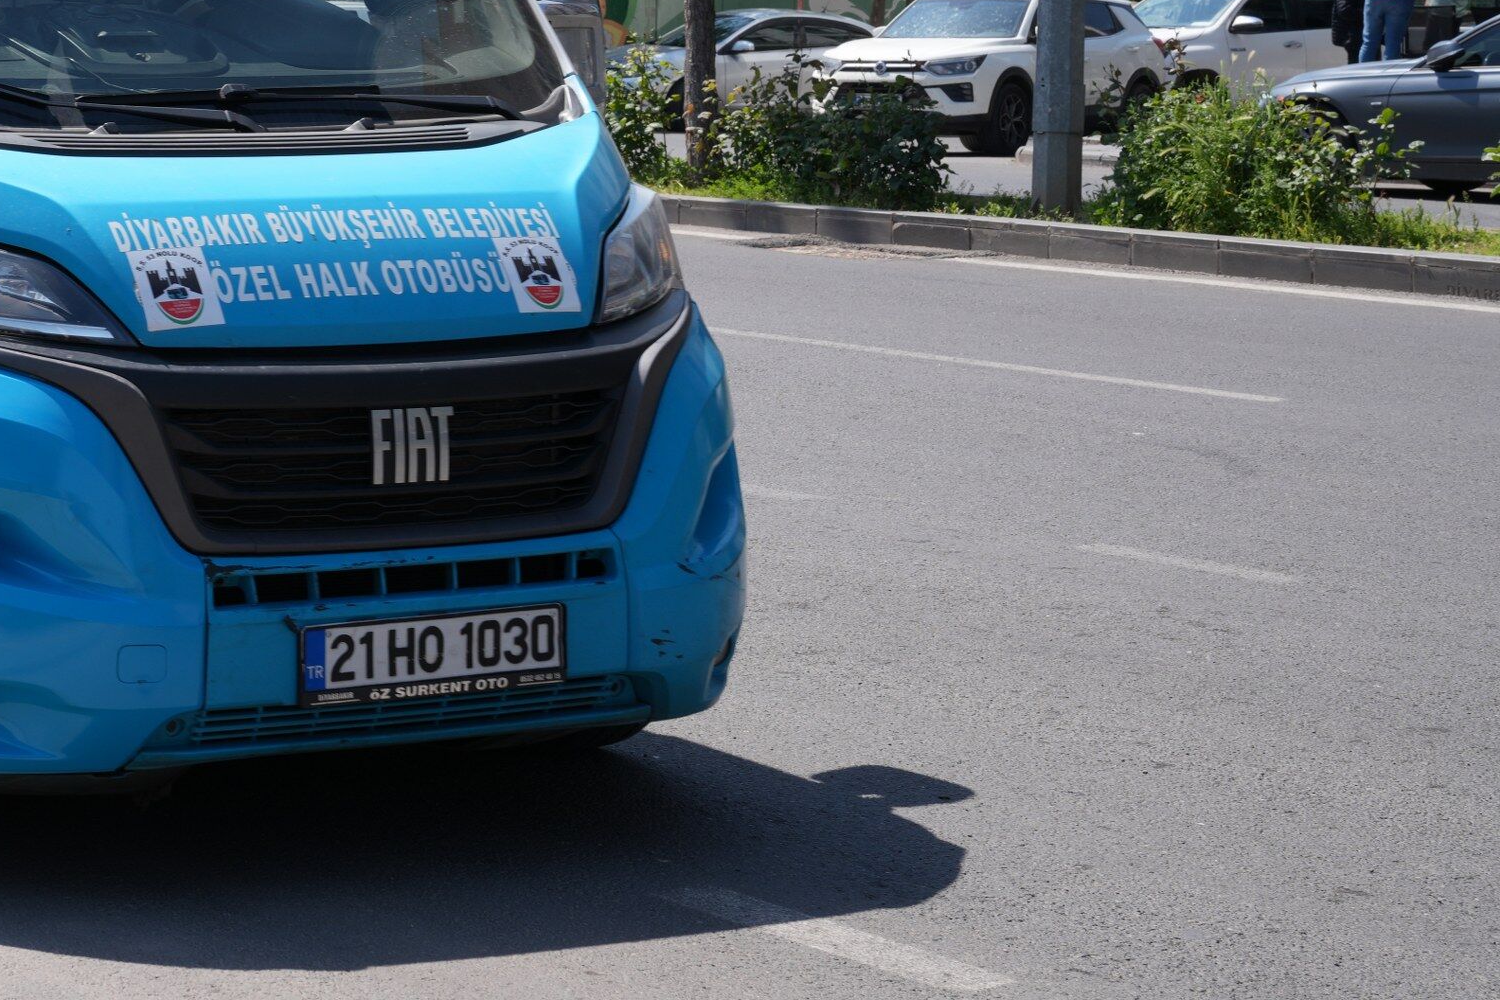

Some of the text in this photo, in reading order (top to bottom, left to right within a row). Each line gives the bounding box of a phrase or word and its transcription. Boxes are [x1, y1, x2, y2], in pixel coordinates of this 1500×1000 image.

[108, 201, 561, 253] DİYARBAKIR BÜYÜKŞEHİR BELEDİYESİ
[209, 251, 513, 304] ÖZEL HALK OTOBÜSÜ
[371, 406, 455, 485] FIAT
[306, 665, 325, 679] TR
[330, 614, 555, 683] 21 HO 1030
[393, 681, 473, 699] SURKENT
[475, 678, 509, 690] OTO
